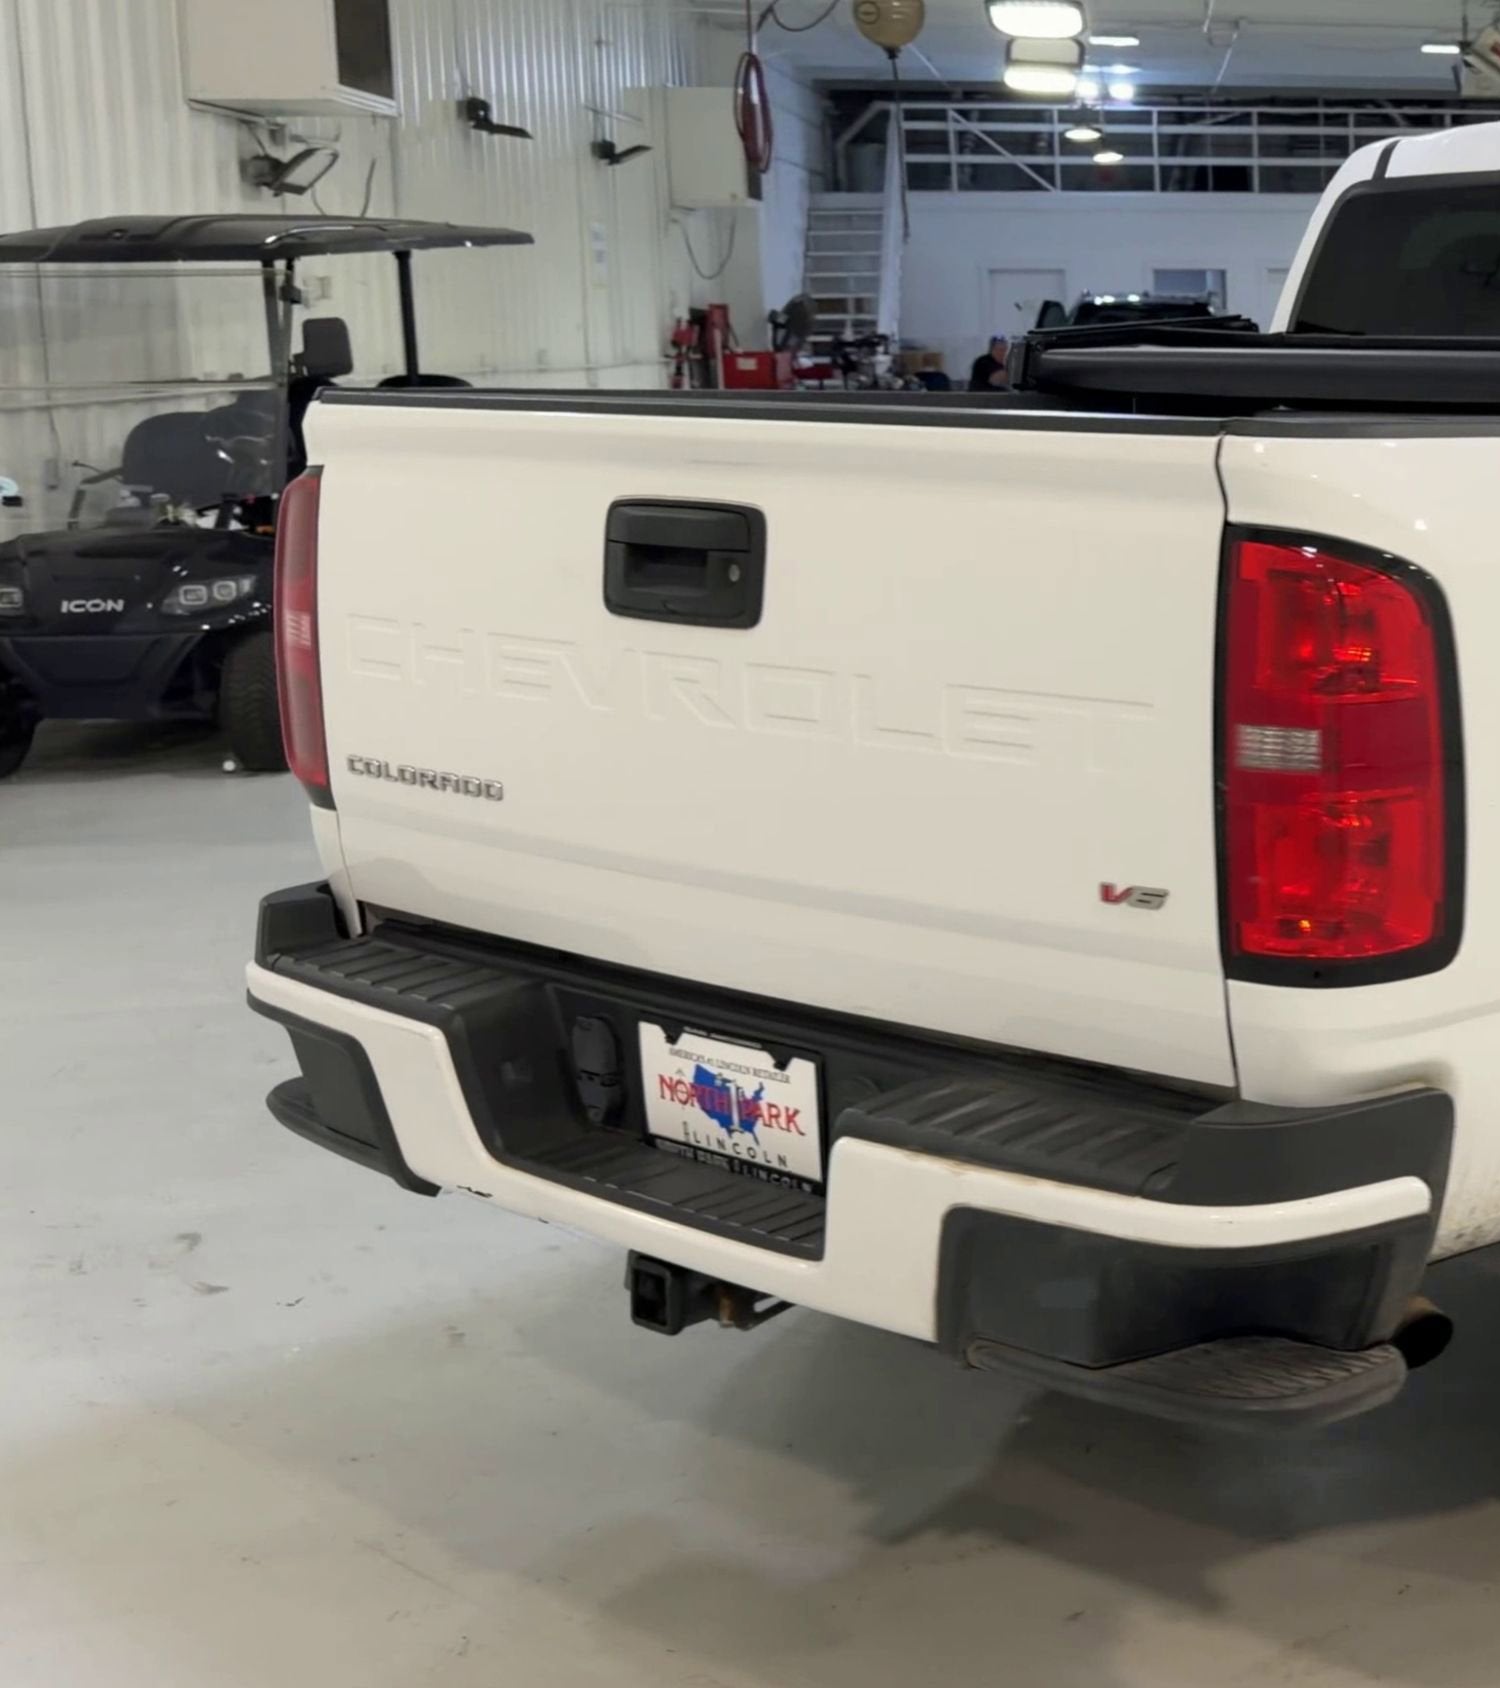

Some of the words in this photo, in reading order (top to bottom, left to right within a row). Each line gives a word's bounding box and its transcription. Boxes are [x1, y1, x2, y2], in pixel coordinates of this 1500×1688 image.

[61, 598, 124, 613] ICON
[346, 612, 1155, 776] CHEVROLET
[347, 754, 504, 801] COLORADO
[1099, 882, 1170, 911] V6
[658, 1073, 730, 1118] NORTH
[694, 1131, 788, 1169] LINCOLN
